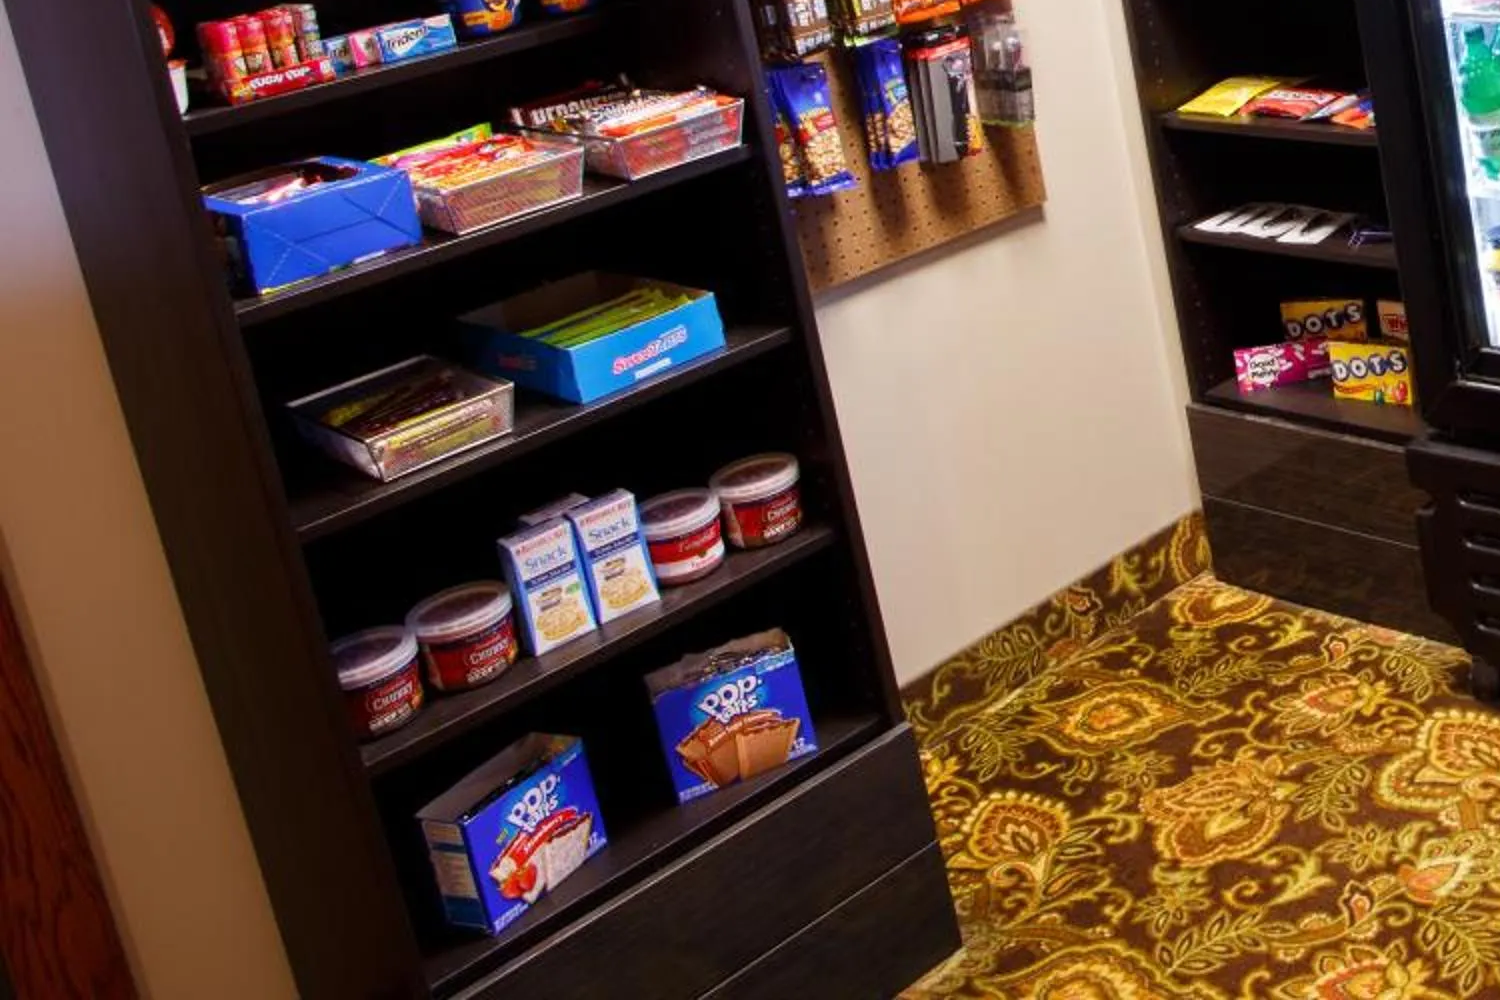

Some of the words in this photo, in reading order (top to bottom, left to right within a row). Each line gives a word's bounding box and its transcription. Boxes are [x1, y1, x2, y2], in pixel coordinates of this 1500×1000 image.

[385, 26, 429, 48] Trident
[1287, 305, 1361, 337] DOTS
[1333, 350, 1405, 381] DOTS
[588, 517, 631, 540] Snack
[524, 546, 568, 571] Snack
